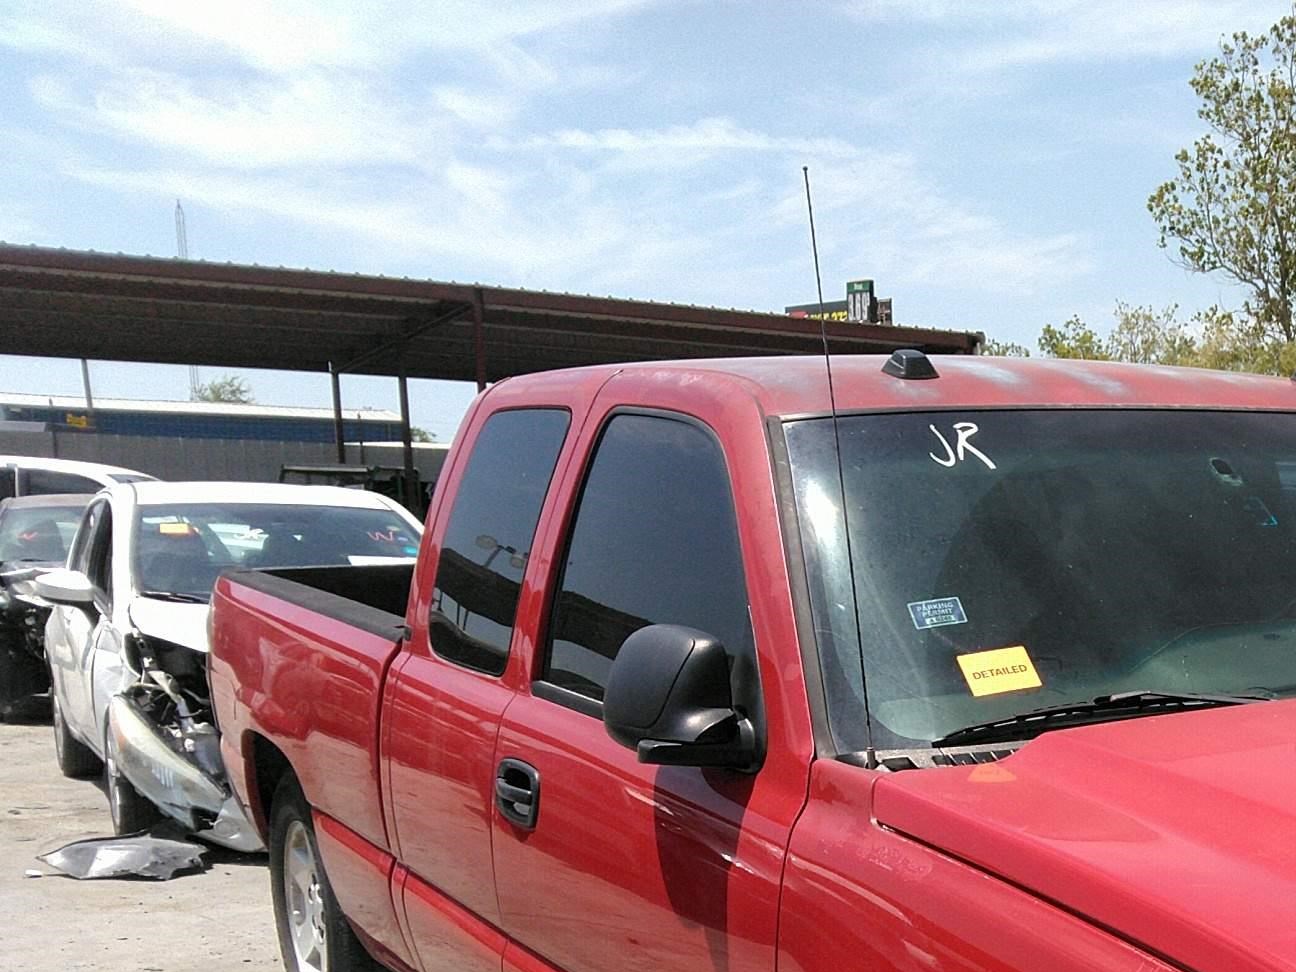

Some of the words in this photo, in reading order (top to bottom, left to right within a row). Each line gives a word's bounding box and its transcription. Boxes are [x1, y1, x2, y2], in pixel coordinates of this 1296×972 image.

[928, 422, 997, 470] JR
[916, 601, 954, 611] PARKING
[922, 608, 953, 617] PERMIT
[972, 664, 1028, 680] DETAILED
